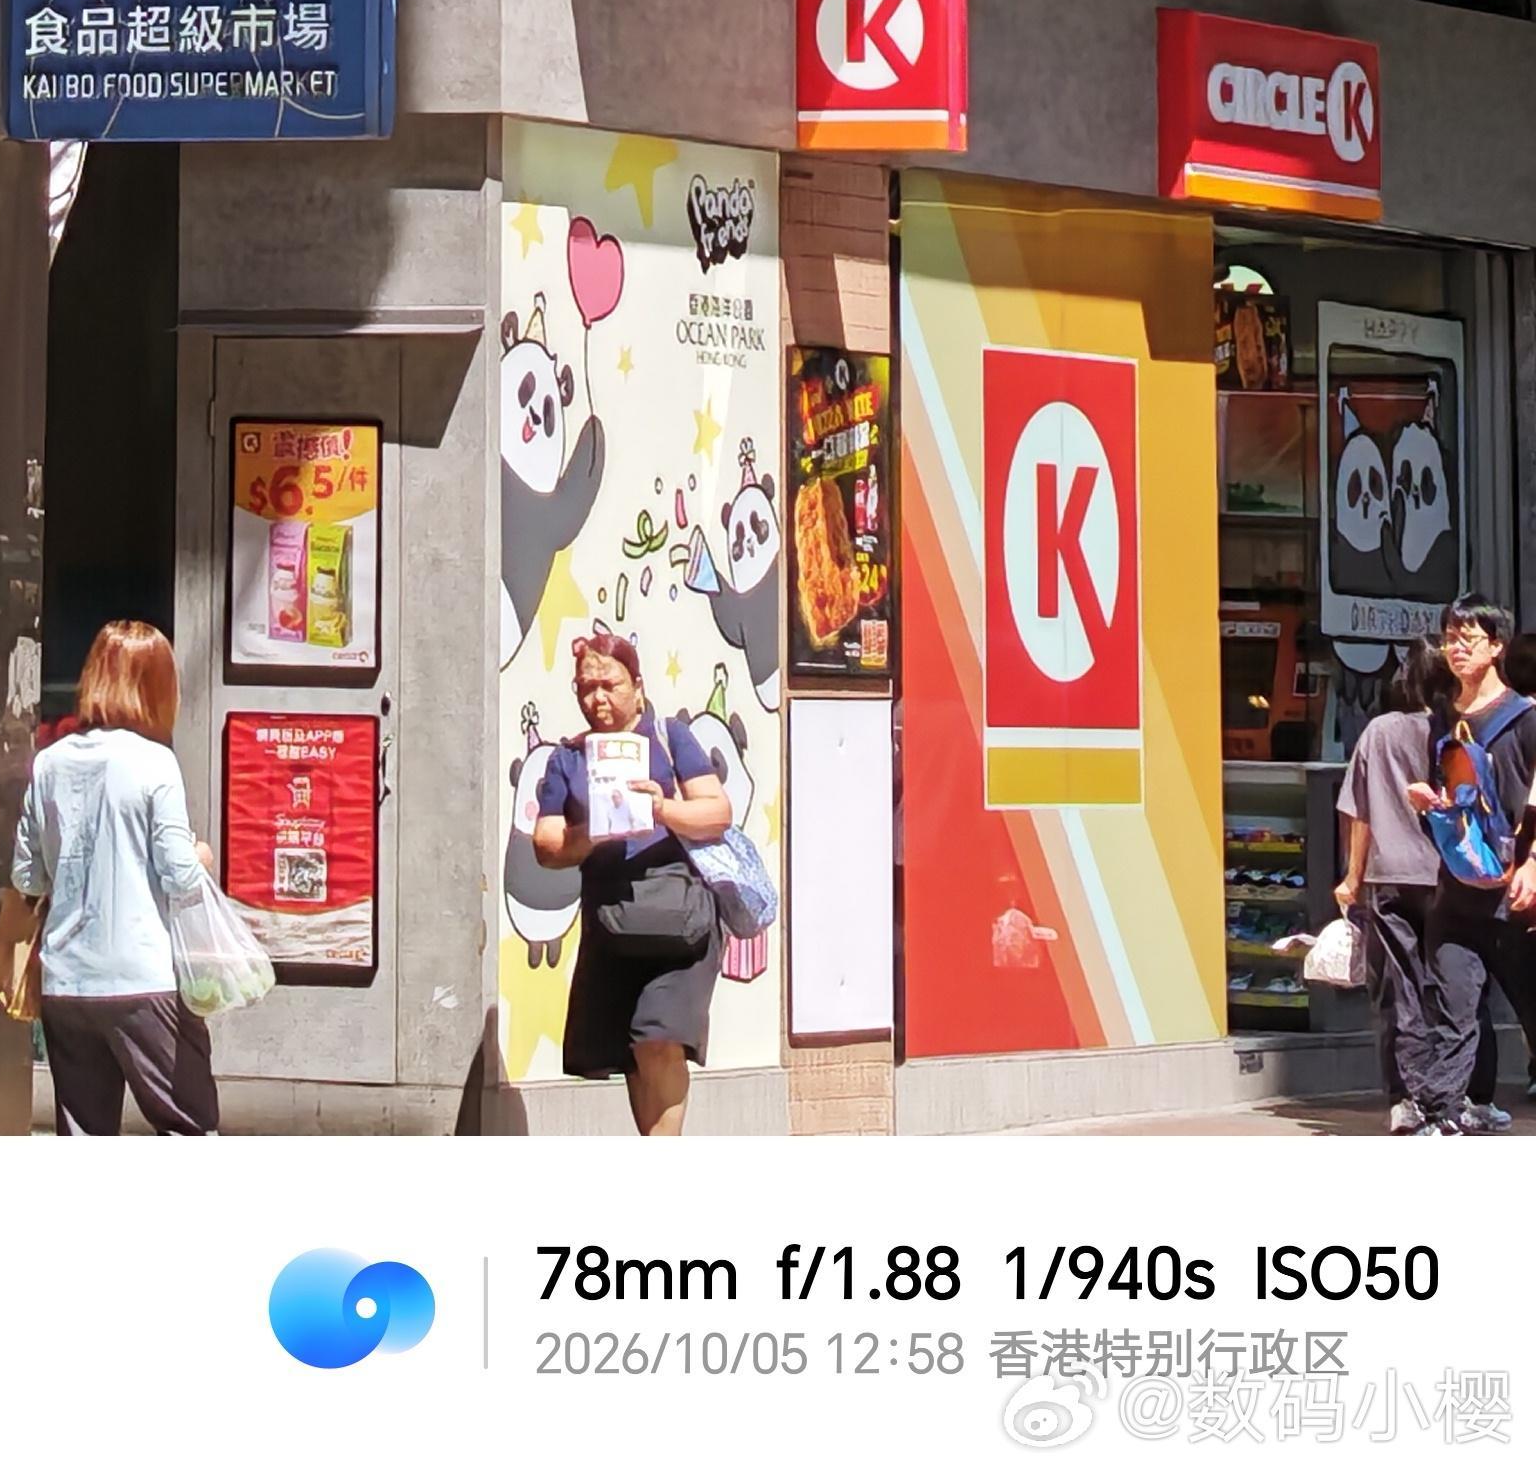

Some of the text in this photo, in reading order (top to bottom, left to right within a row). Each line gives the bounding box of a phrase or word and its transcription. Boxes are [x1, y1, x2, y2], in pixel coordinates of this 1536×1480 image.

[24, 2, 331, 57] 食品超級市場
[23, 69, 337, 100] KAI BO FOOD SUPERMARKET
[1207, 62, 1327, 136] CIRCLE
[675, 320, 766, 352] OCEAN PARK
